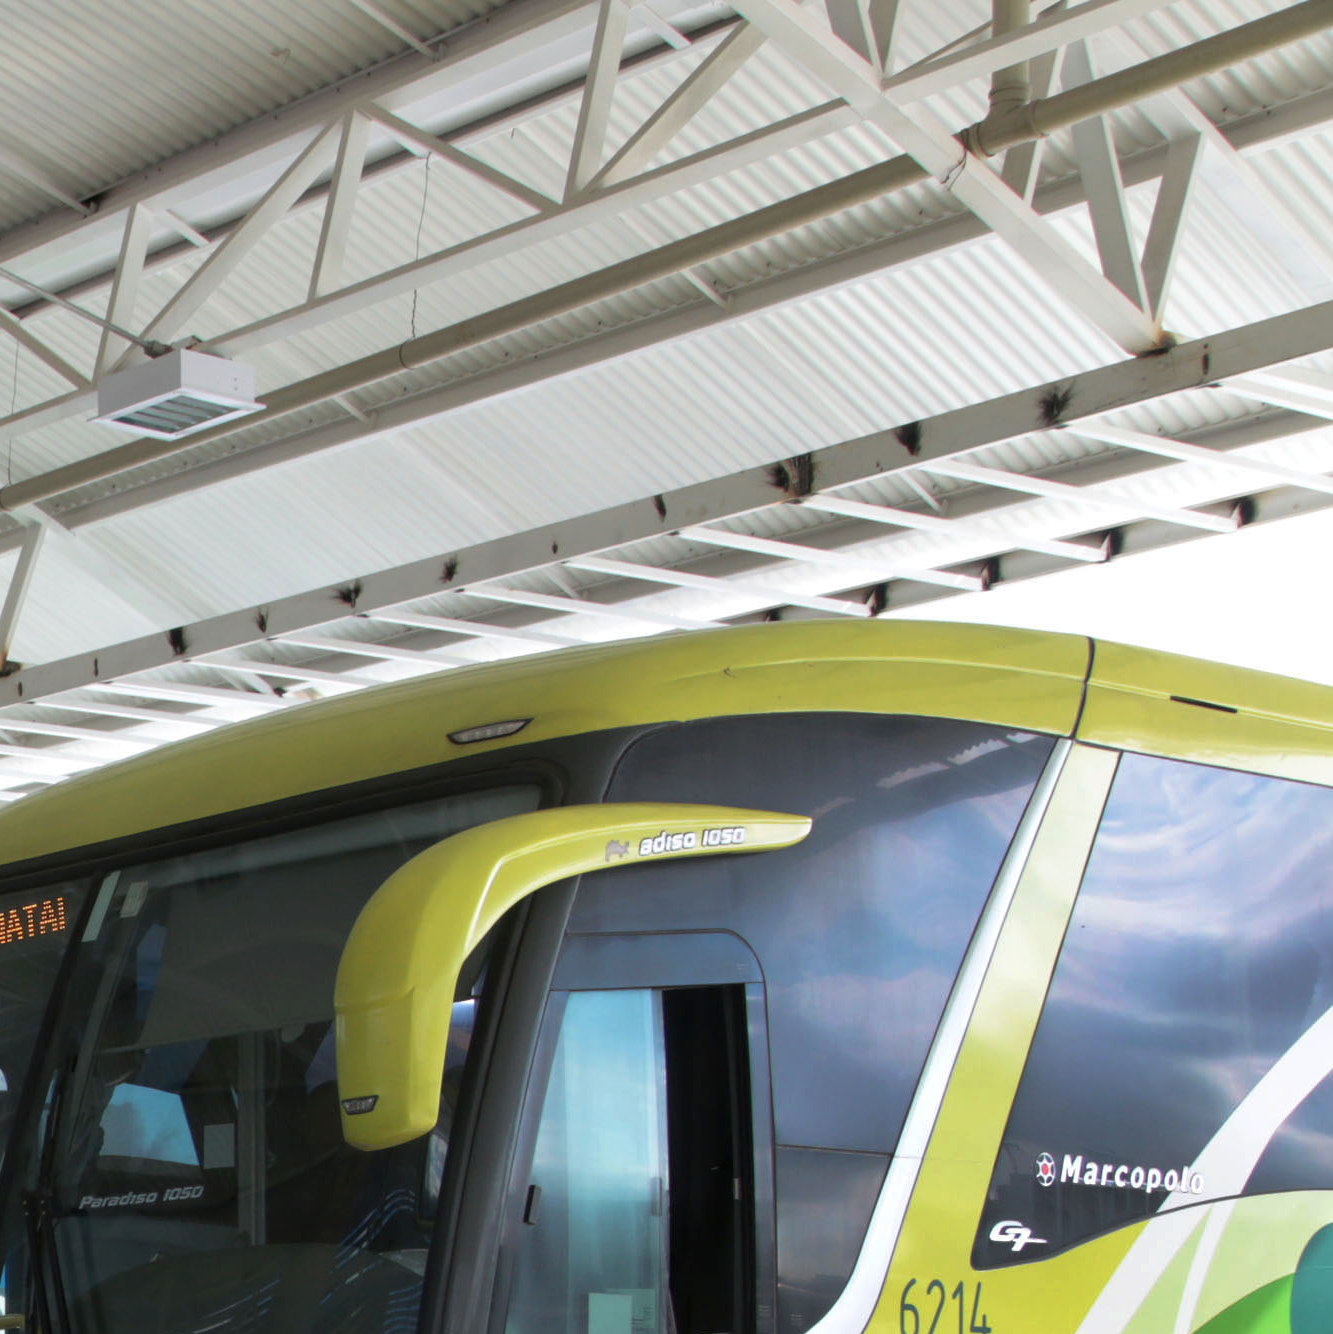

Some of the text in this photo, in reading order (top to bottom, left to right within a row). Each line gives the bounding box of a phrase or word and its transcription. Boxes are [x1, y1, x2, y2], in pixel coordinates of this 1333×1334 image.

[702, 827, 746, 847] 1050
[1060, 1154, 1205, 1194] Marcopolo
[79, 1185, 204, 1210] Paradiso 1050
